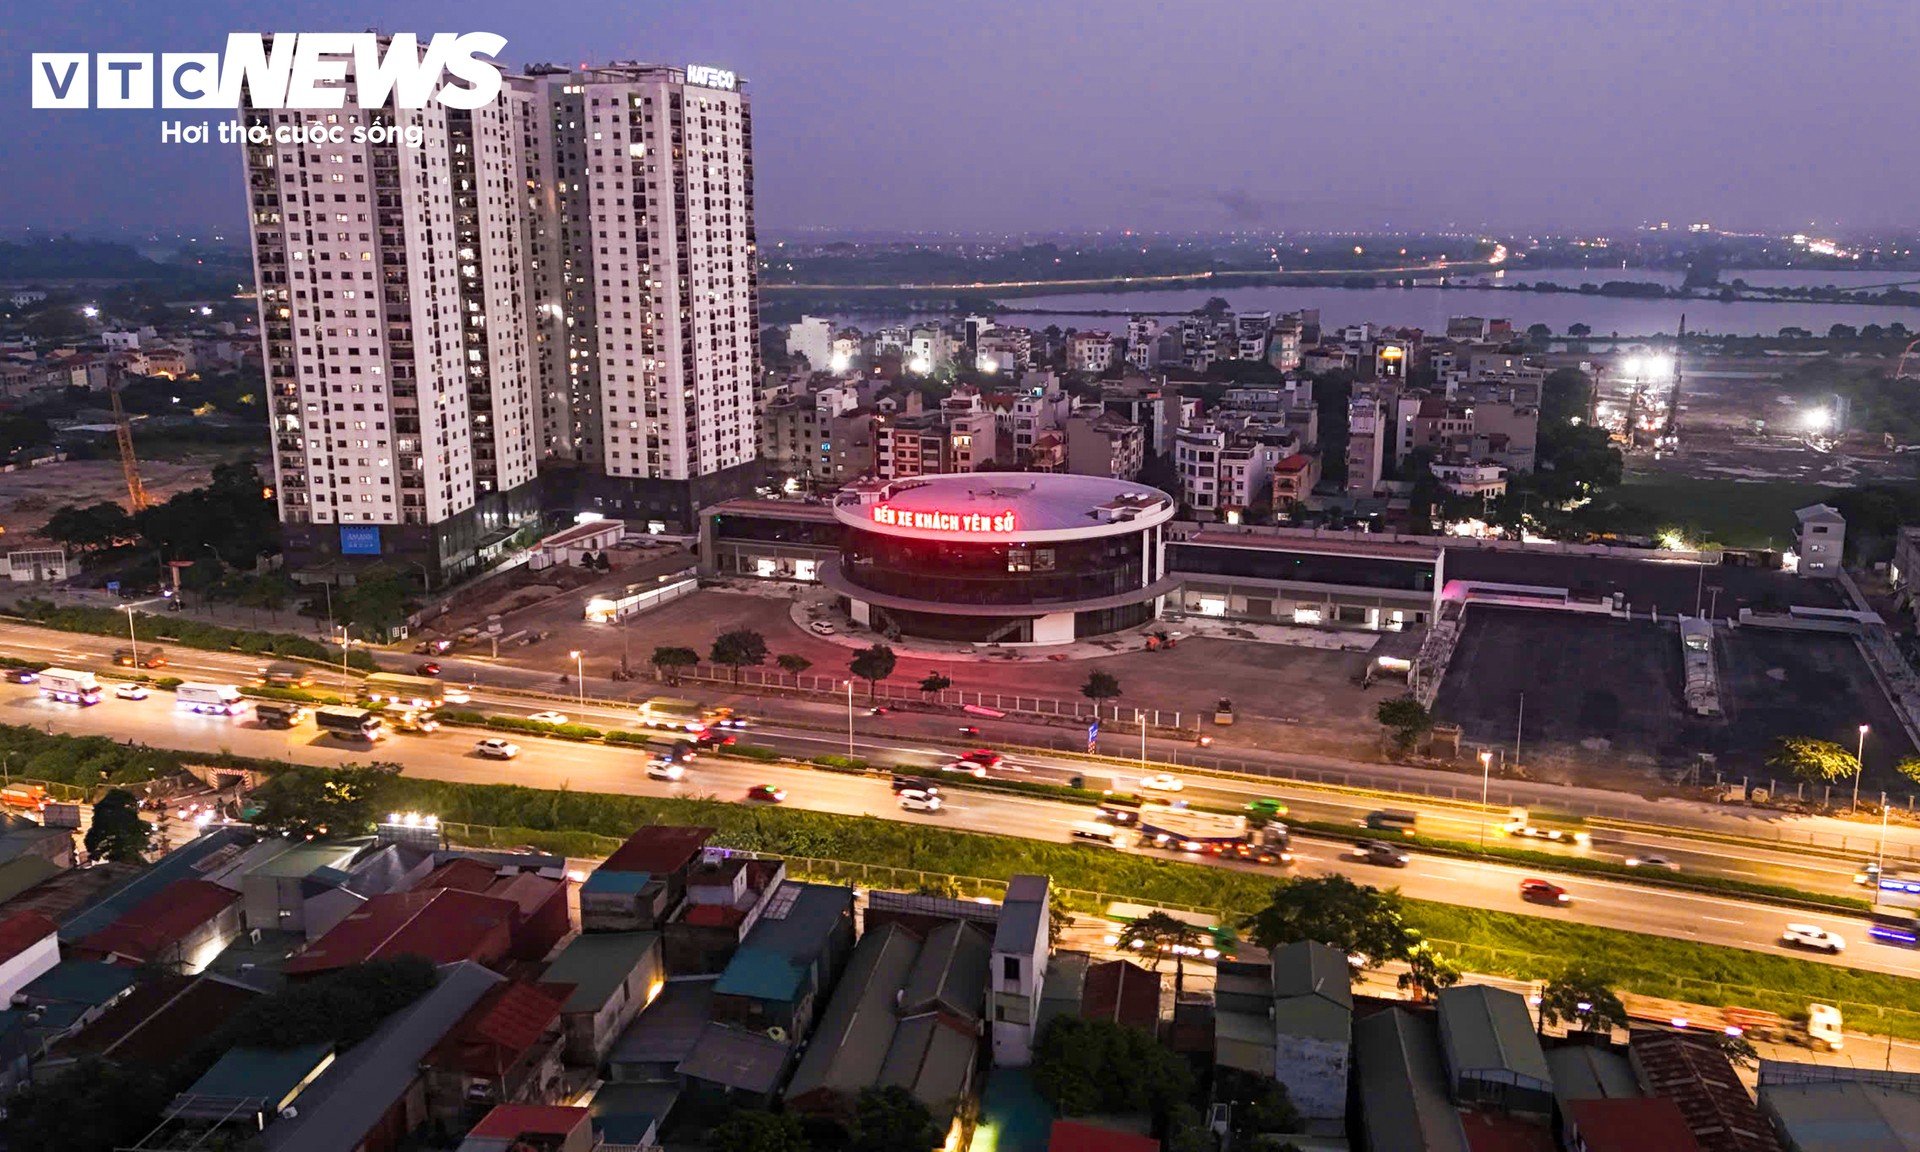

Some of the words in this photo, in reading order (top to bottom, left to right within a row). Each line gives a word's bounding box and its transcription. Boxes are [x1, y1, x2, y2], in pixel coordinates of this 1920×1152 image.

[686, 64, 735, 89] HATECO
[897, 510, 913, 527] XE
[914, 511, 960, 531] KHÁCH
[963, 513, 991, 532] YÊN
[993, 510, 1016, 533] SỞ
